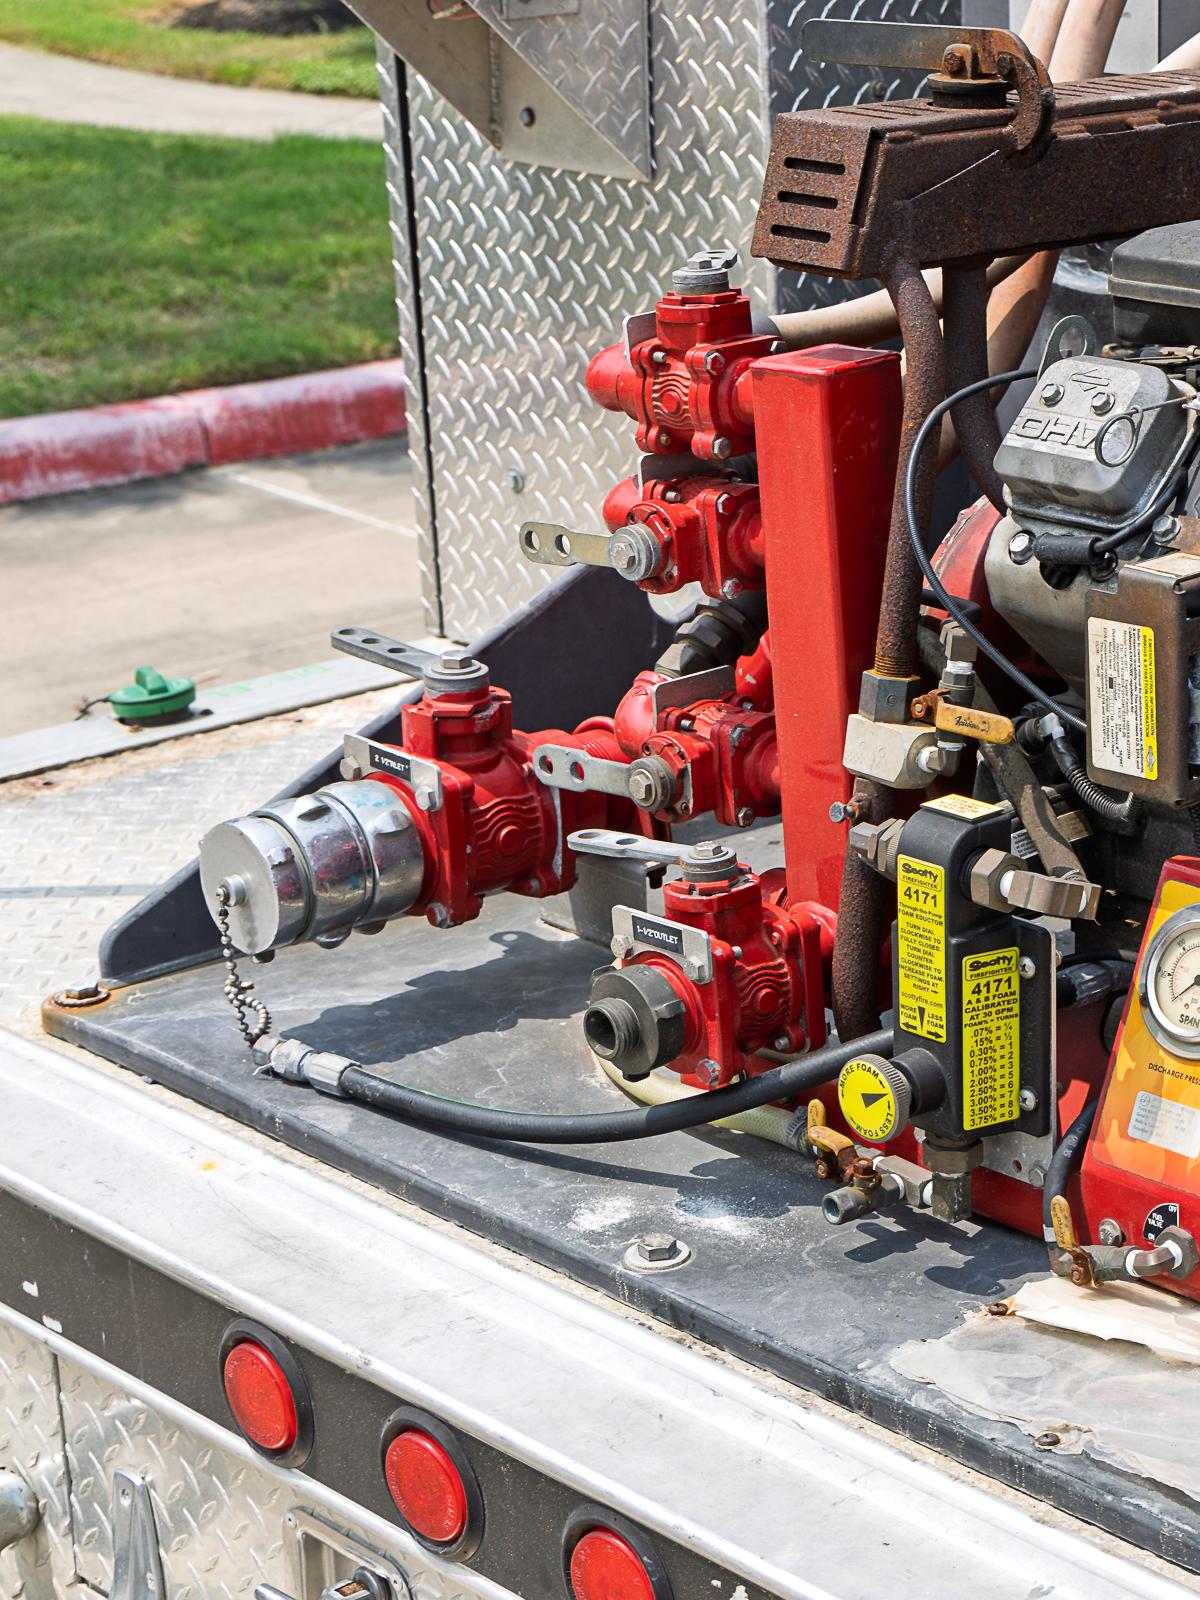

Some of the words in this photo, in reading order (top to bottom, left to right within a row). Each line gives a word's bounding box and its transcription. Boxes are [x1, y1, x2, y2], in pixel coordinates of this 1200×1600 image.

[901, 862, 938, 883] Scotty
[902, 875, 937, 889] FIREFIGHTER
[903, 886, 936, 907] 4171
[898, 908, 913, 917] FOAM
[915, 913, 943, 926] EDUCTOR
[900, 927, 931, 941] CLOCKWISE
[905, 921, 920, 930] TURN
[922, 926, 934, 935] DIAL
[900, 934, 916, 944] FULLY
[906, 944, 921, 953] TURN
[922, 949, 934, 957] DIAL
[901, 957, 931, 971] CLOCKWISE
[968, 955, 1013, 971] Scotty
[903, 972, 929, 985] SETTINGS
[970, 966, 1012, 978] FIREFIGHTER
[912, 983, 929, 991] RIGHT
[971, 975, 1011, 995] 4171
[901, 991, 943, 1008] scottyfire.com
[992, 990, 1016, 1000] FOAM
[900, 1003, 916, 1013] MORE
[964, 997, 1017, 1013] CALIBRATED
[900, 1010, 916, 1020] FOAM
[927, 1012, 942, 1021] LESS
[964, 1019, 988, 1028] FOAM%
[996, 1012, 1018, 1021] TURNS
[969, 1013, 980, 1021] AT
[982, 1010, 992, 1018] 30
[994, 1006, 1013, 1015] GPM
[1179, 1013, 1200, 1029] SPAN
[927, 1019, 943, 1029] FOAM
[971, 1025, 992, 1038] .07%
[971, 1035, 992, 1048] .15%
[969, 1044, 996, 1058] 0.30%
[1008, 1041, 1012, 1049] 1
[969, 1054, 996, 1068] 0.75%
[1007, 1050, 1013, 1059] 2
[840, 1064, 855, 1088] MORE
[856, 1063, 880, 1080] FOAM
[969, 1064, 997, 1077] 1.00%
[1008, 1060, 1013, 1069] 3
[1148, 1062, 1184, 1080] DISCHARGE
[969, 1074, 996, 1088] 2.00%
[1008, 1070, 1013, 1079] 5
[969, 1083, 996, 1097] 2.50%
[1007, 1080, 1013, 1088] 6
[969, 1093, 996, 1107] 3.00%
[1007, 1089, 1013, 1098] 7
[970, 1103, 997, 1117] 3.50%
[1007, 1099, 1013, 1108] 8
[879, 1112, 893, 1134] LESS
[970, 1113, 997, 1126] 3.75%
[1007, 1109, 1013, 1117] 9
[856, 1123, 879, 1138] FOAM
[1168, 1205, 1177, 1213] OFF
[1147, 1218, 1163, 1229] VALVE
[1152, 1212, 1164, 1222] FUEL
[1147, 1232, 1155, 1241] ON
